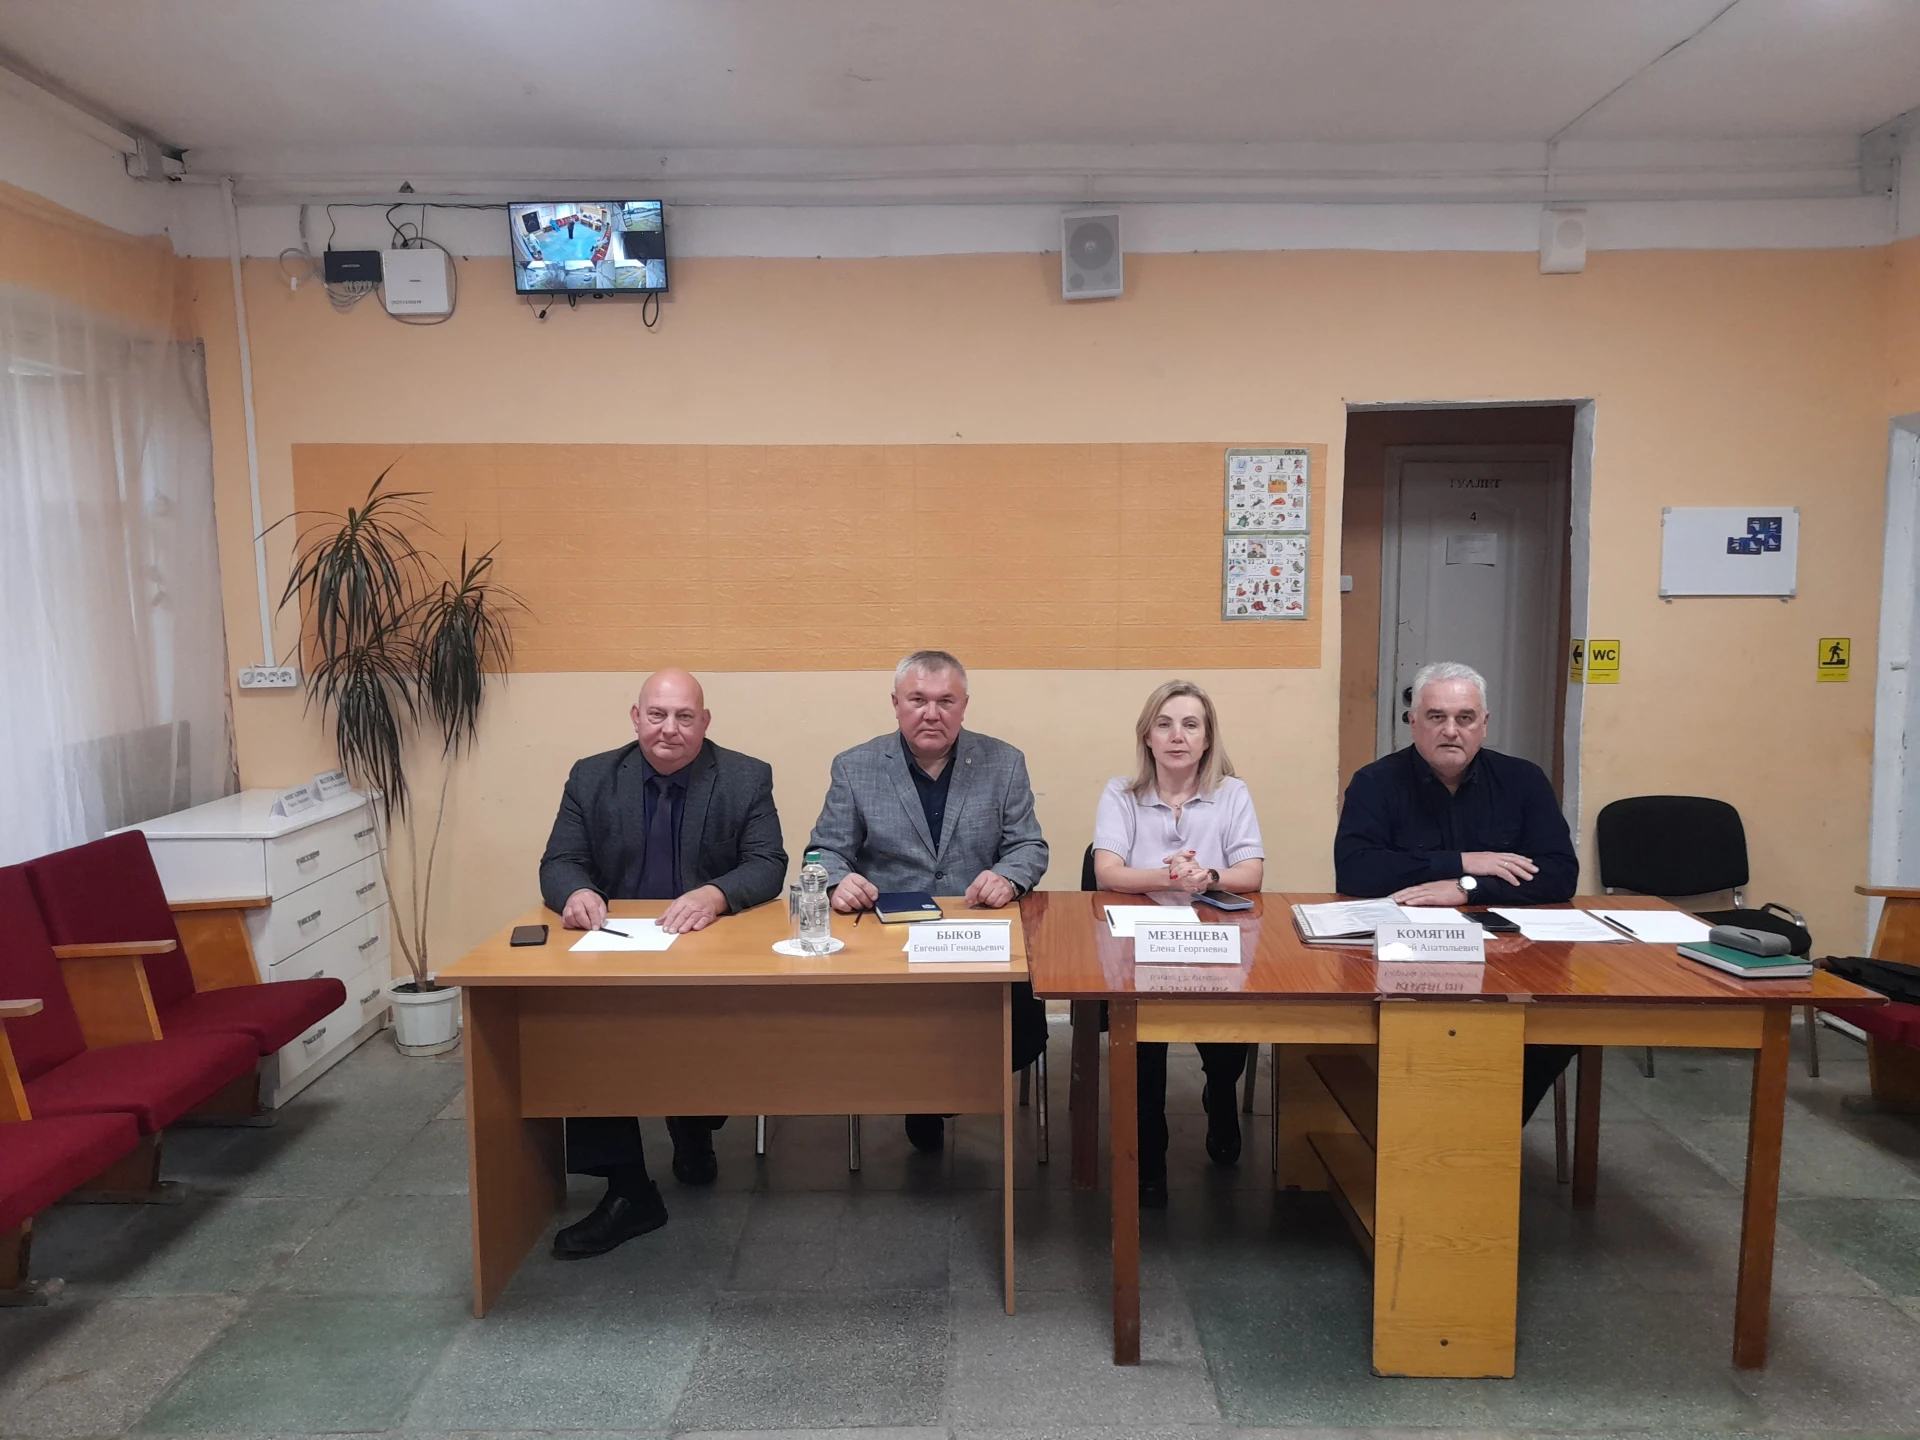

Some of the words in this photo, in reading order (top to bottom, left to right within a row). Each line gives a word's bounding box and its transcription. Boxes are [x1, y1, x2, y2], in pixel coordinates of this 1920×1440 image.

[1469, 512, 1477, 522] 4
[1592, 649, 1616, 661] WC
[936, 930, 982, 940] БЫКОВ
[1147, 930, 1230, 942] МЕЗЕНЦЕВА
[1396, 930, 1466, 940] КОМЯГИН
[914, 944, 948, 952] Евгений
[950, 944, 1005, 952] Геннадьевич
[1150, 944, 1176, 952] Елена
[1178, 944, 1228, 954] Георгиевна
[1420, 943, 1480, 952] Анатольевич
